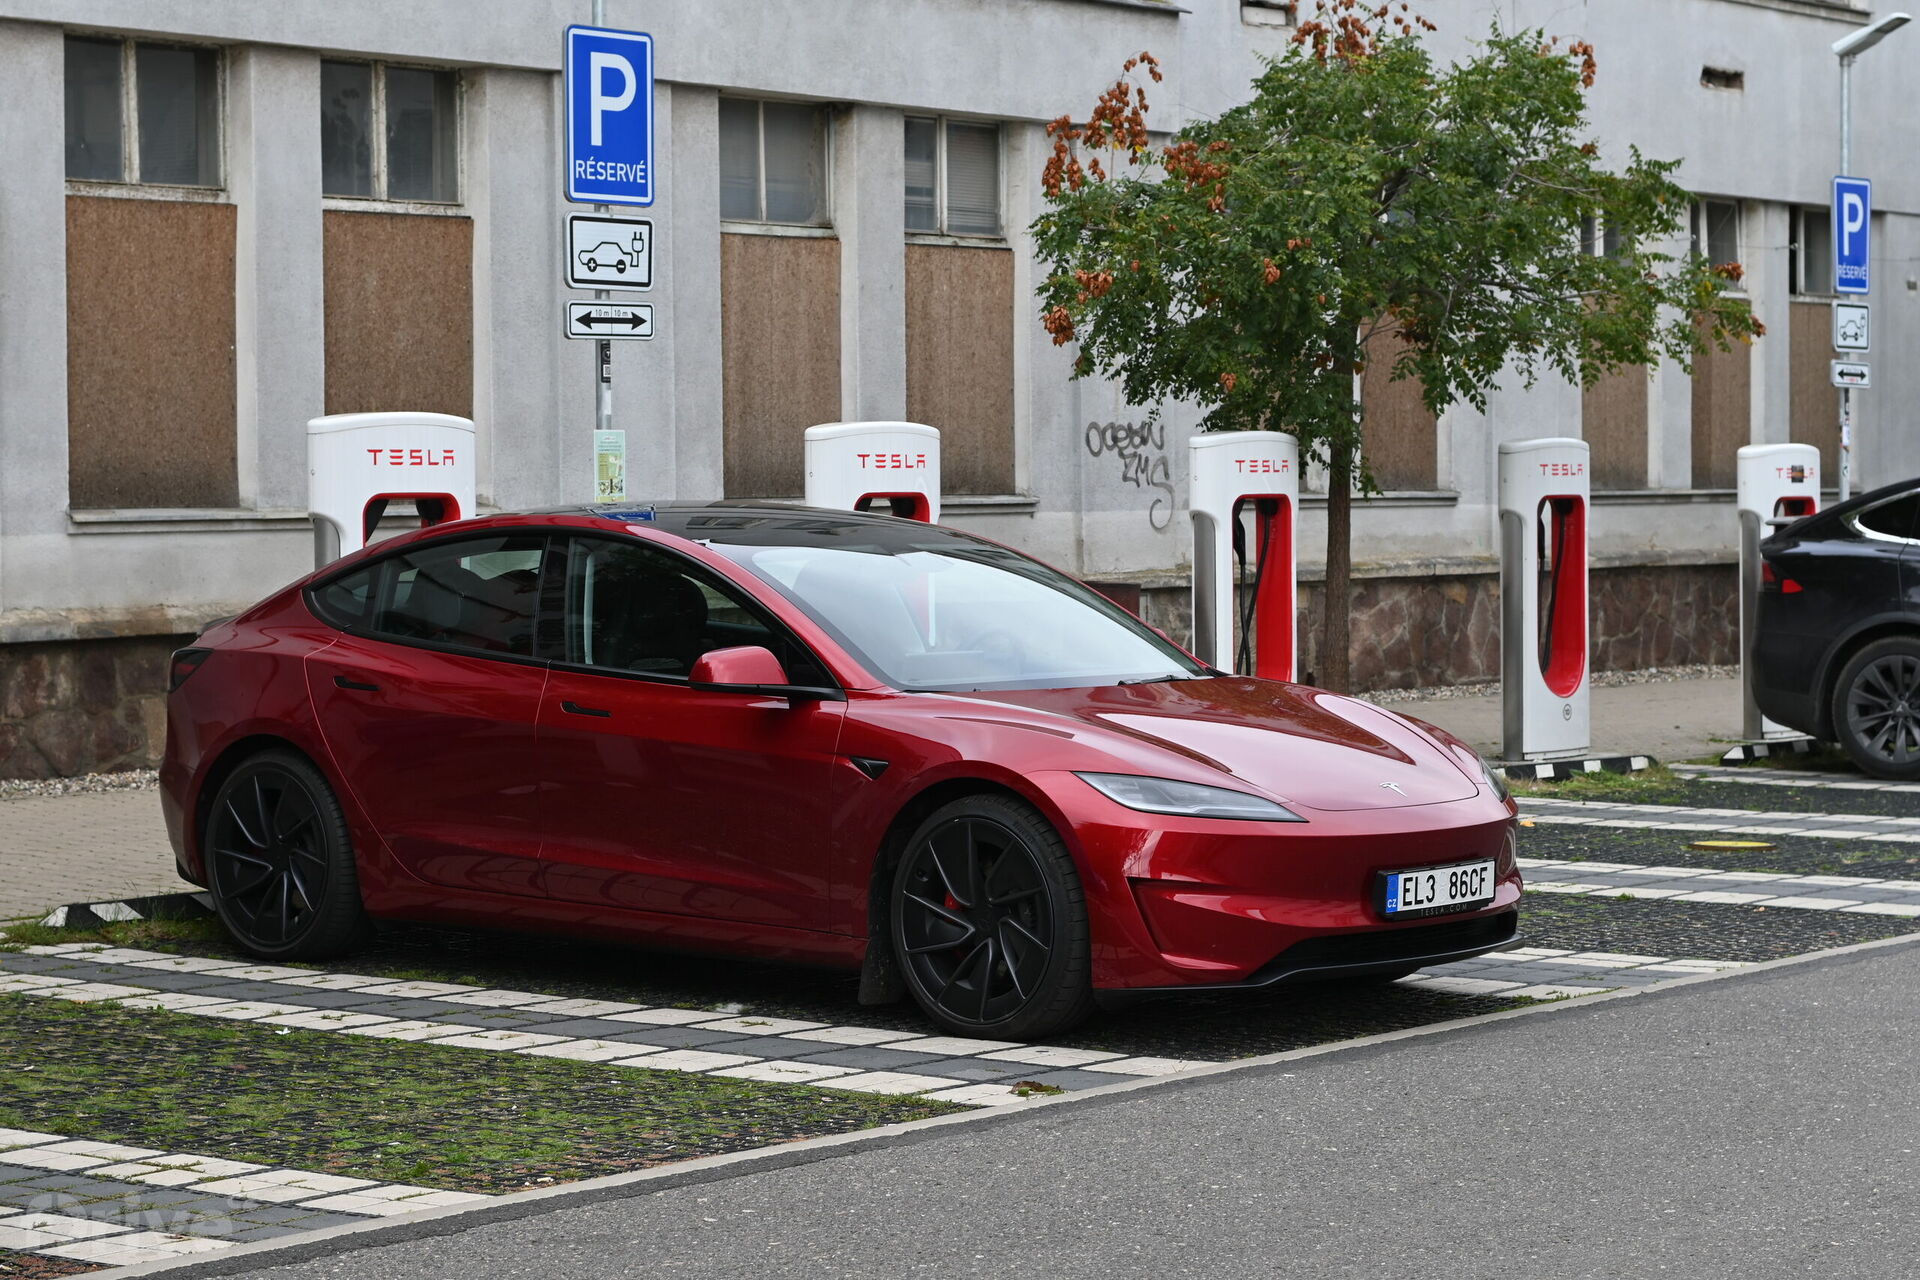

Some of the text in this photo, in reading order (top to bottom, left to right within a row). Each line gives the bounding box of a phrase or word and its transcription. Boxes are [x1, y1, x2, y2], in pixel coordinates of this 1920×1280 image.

[590, 51, 637, 146] P
[575, 156, 646, 184] RÉSERVÉ
[1843, 192, 1864, 256] P
[366, 449, 454, 466] TESLA
[857, 454, 926, 469] TESLA
[1234, 459, 1289, 473] TESLA
[1539, 463, 1583, 476] TESLA
[1402, 866, 1488, 907] EL3 86CF
[1387, 898, 1397, 909] CZ
